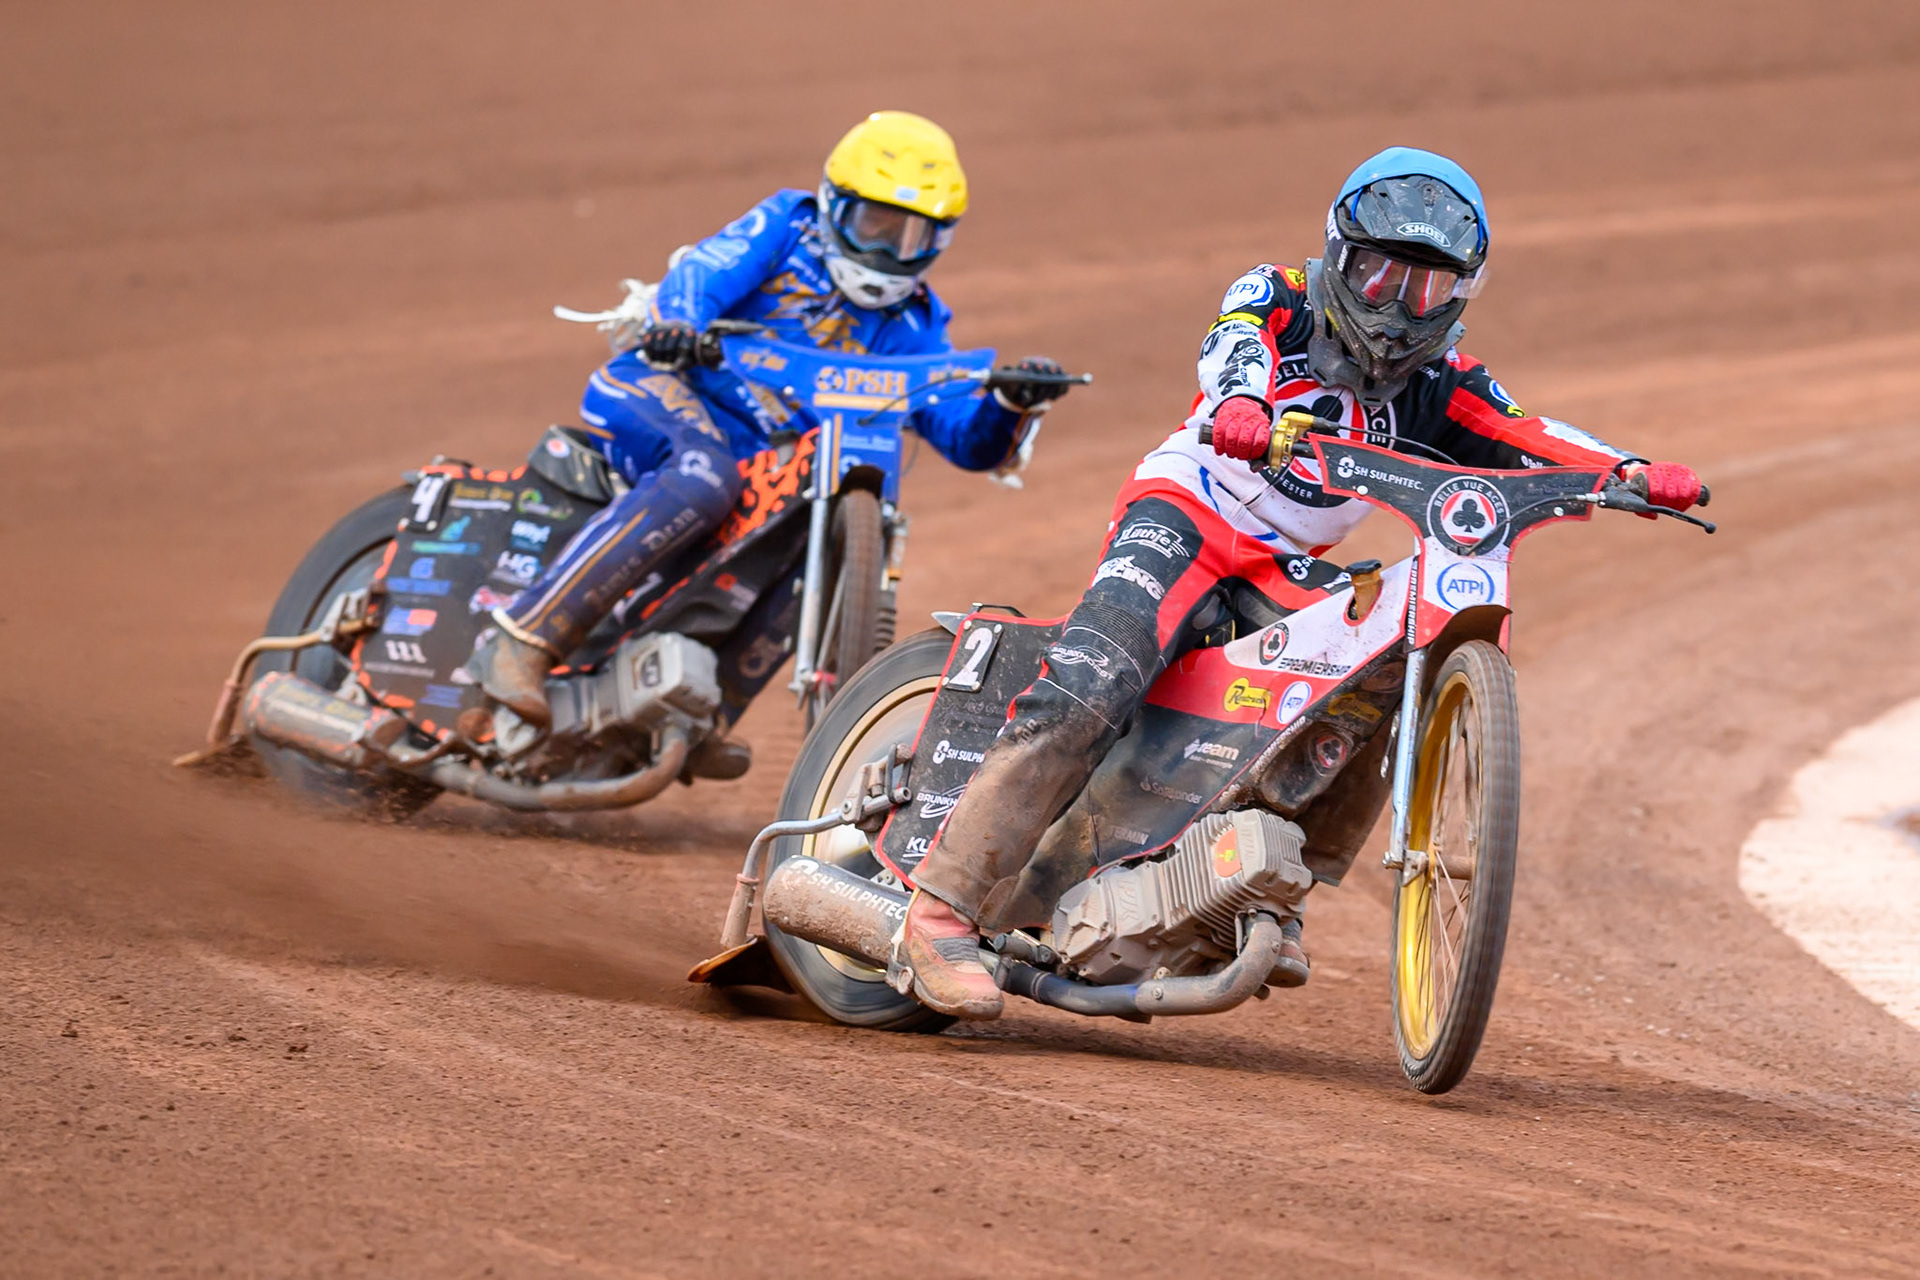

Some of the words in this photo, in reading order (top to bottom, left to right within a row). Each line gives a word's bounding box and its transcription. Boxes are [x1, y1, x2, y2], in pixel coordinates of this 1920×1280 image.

[1404, 224, 1446, 244] SHOEI
[843, 368, 907, 395] PSH
[1354, 465, 1368, 476] SH
[1433, 482, 1460, 507] BELLE
[1462, 480, 1485, 493] VUE
[1485, 490, 1505, 514] ACES
[1446, 578, 1484, 596] ATPI
[949, 627, 993, 686] 2
[946, 748, 959, 760] SH
